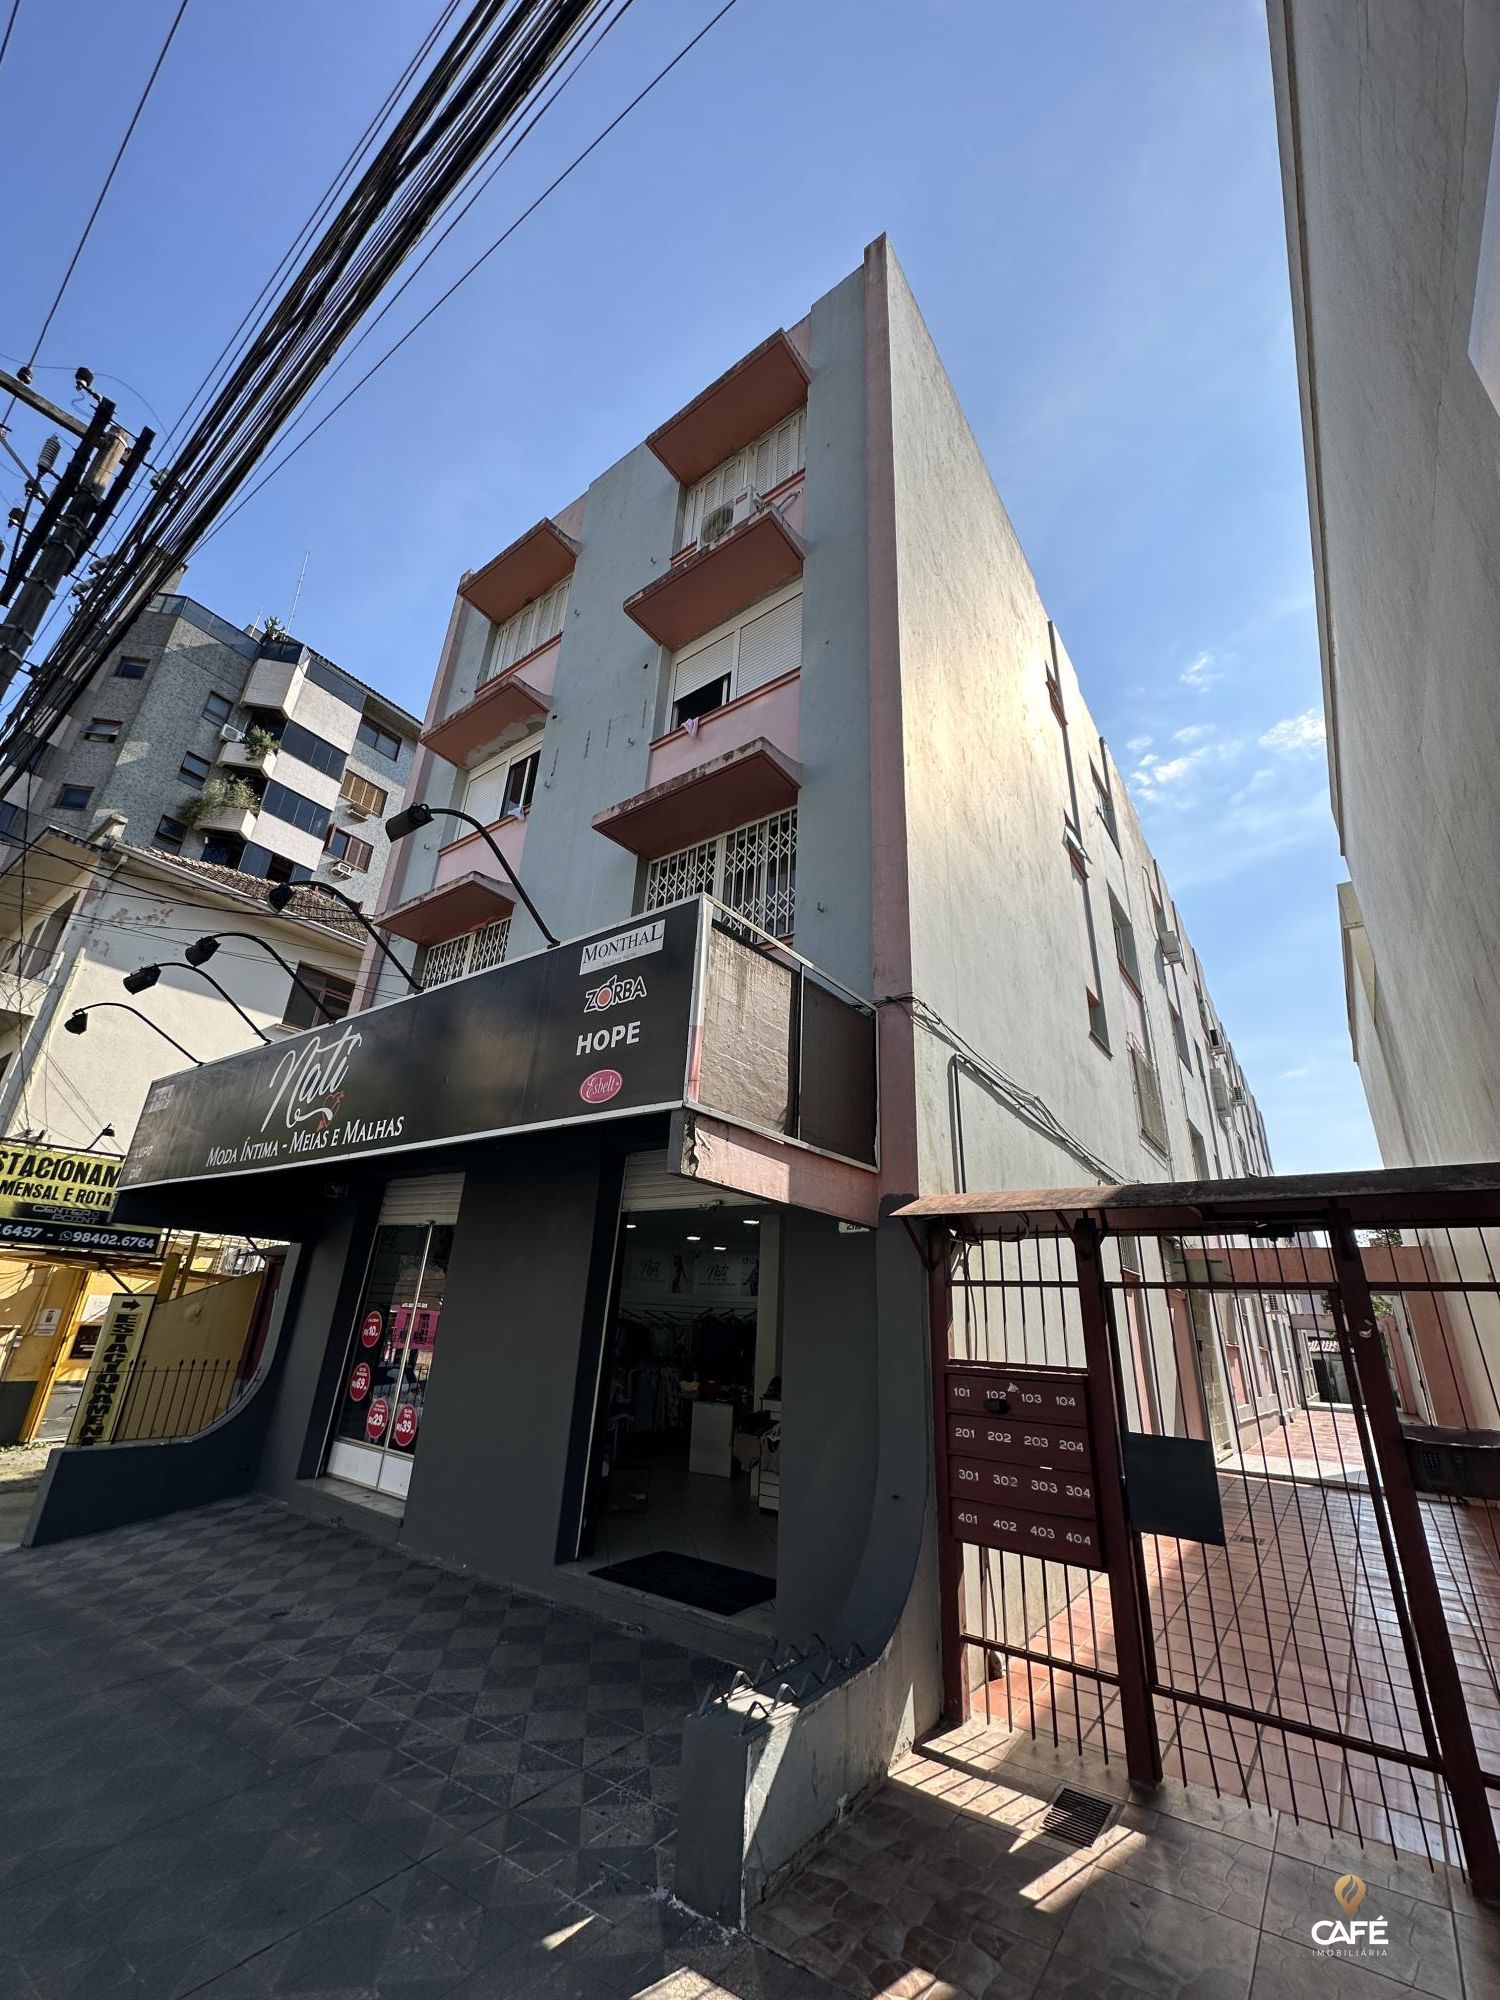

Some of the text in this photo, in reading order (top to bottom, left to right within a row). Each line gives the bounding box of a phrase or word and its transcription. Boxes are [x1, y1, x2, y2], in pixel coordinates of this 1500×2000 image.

[582, 923, 663, 964] MONTHAL
[583, 975, 648, 1013] ZORBA
[575, 1021, 641, 1056] HOPE
[260, 1024, 363, 1132] Nati
[205, 1147, 237, 1167] MODA
[239, 1136, 279, 1162] ÍNTIMA
[288, 1129, 327, 1154] MEIAS
[331, 1128, 341, 1147] E
[342, 1116, 405, 1145] MALHAS
[0, 1179, 118, 1207] MENSAL E ROTA
[0, 1224, 44, 1238] 6457
[72, 1231, 155, 1249] 98402.6764
[953, 1387, 1076, 1407] 101 102 103 104
[955, 1427, 1084, 1452] 201 202 203 204
[958, 1469, 1091, 1498] 301 302 303 304
[957, 1513, 1091, 1546] 401 402 403 404
